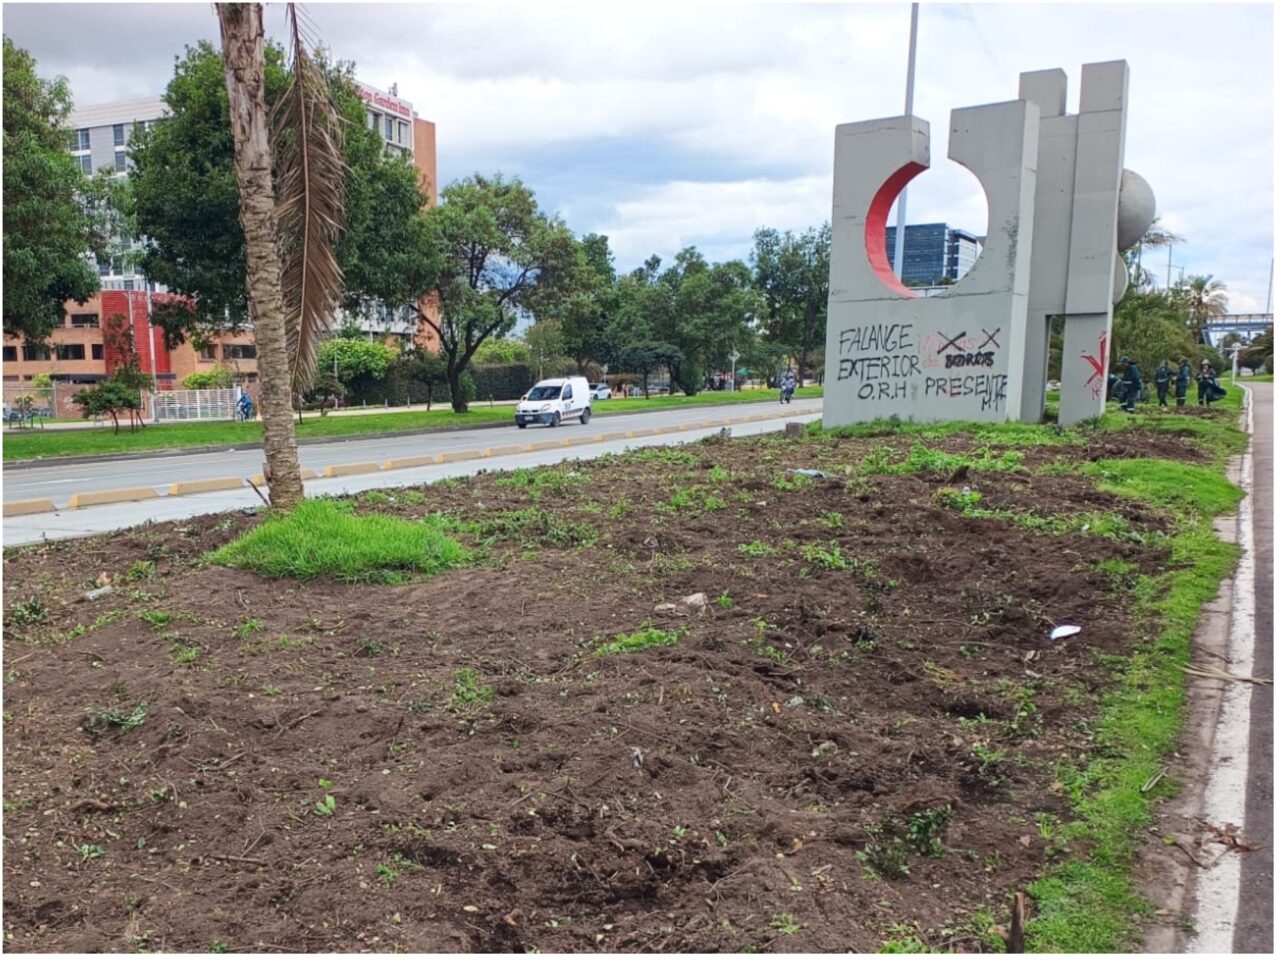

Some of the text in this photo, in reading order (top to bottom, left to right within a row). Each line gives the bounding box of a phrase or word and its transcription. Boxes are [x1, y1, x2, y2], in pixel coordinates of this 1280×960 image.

[839, 324, 913, 355] FALANGE
[837, 355, 922, 382] EXTERIOR
[925, 374, 1008, 399] PRESENTE
